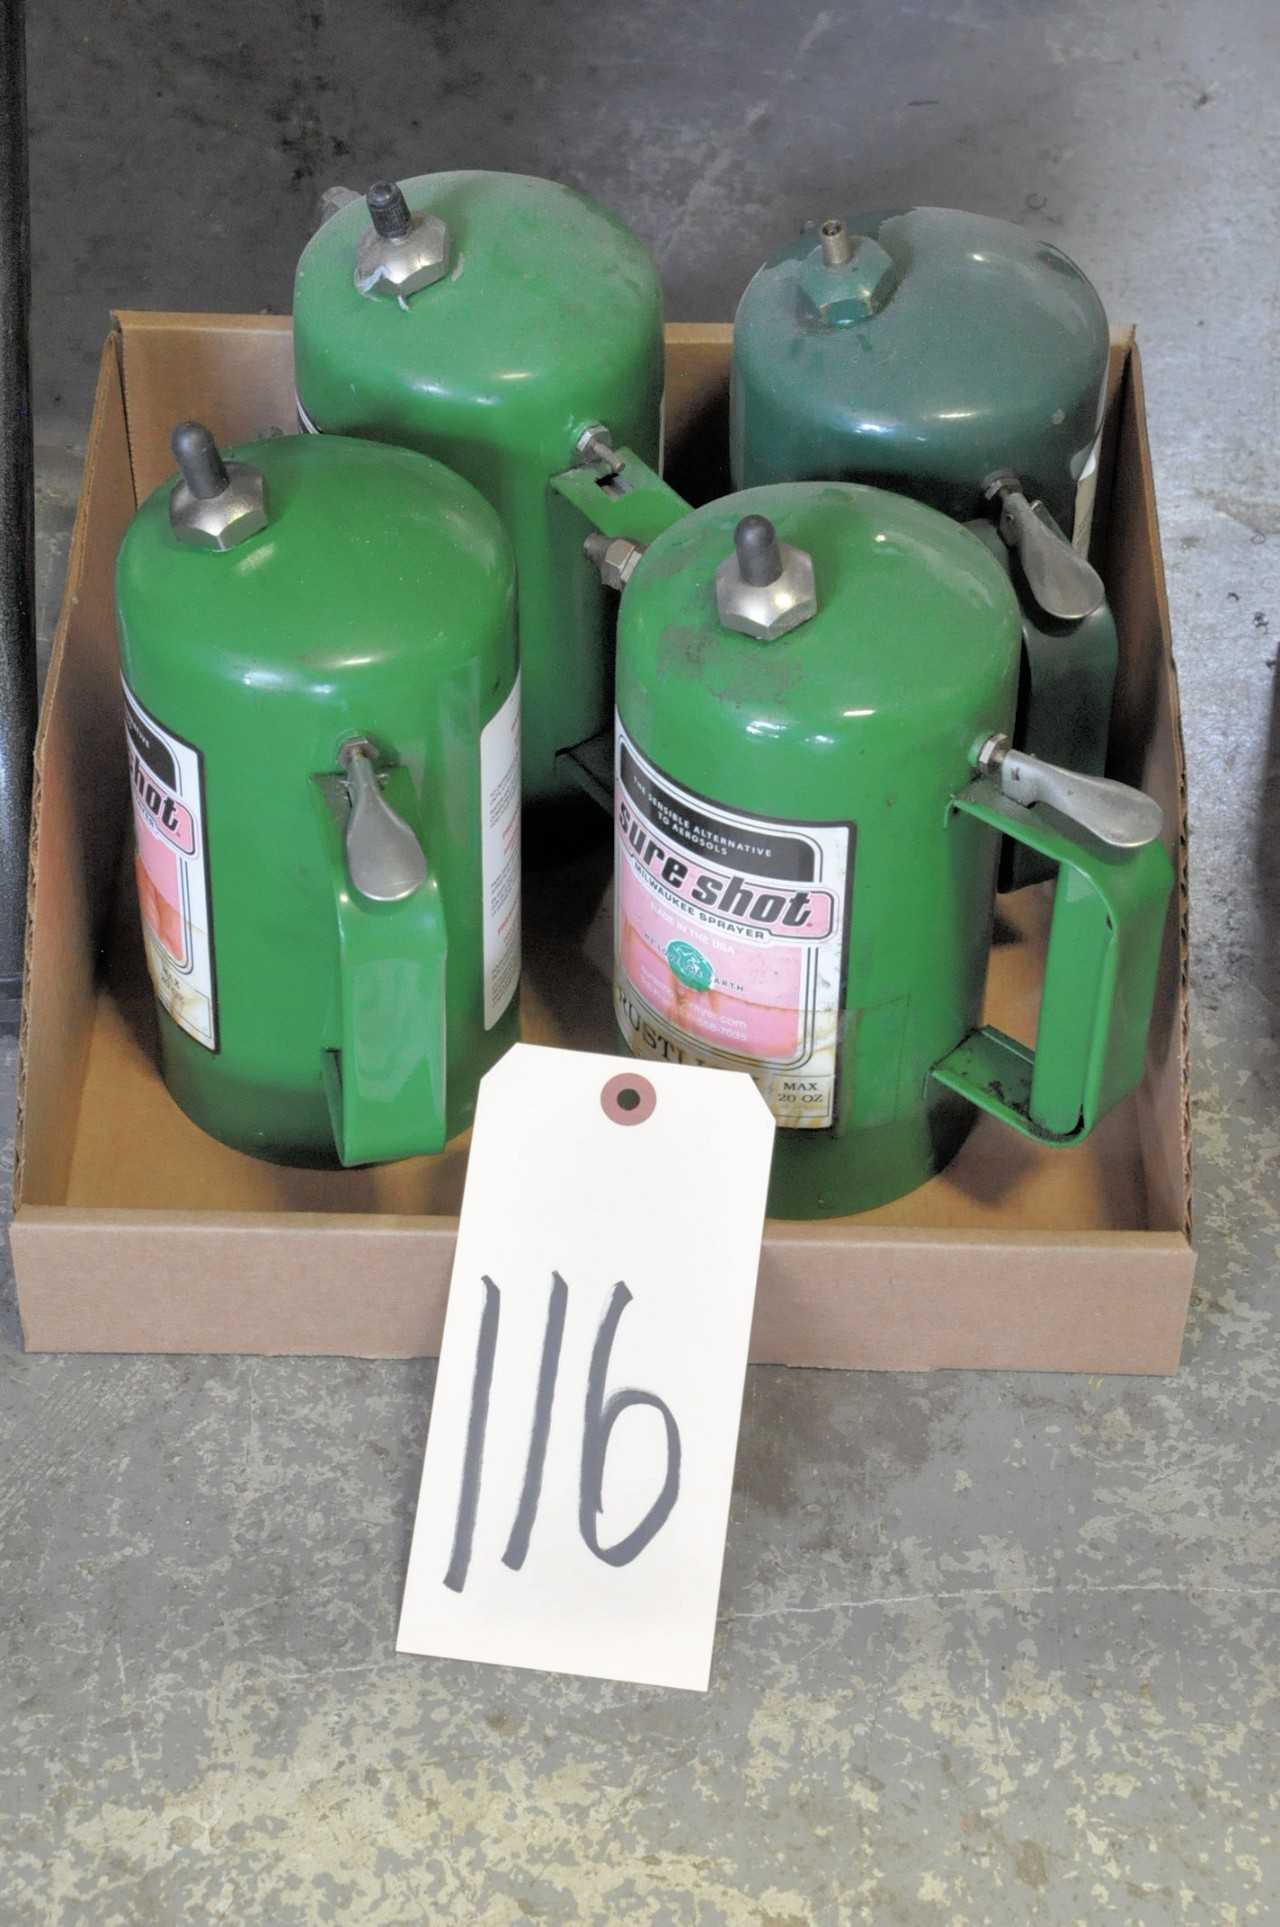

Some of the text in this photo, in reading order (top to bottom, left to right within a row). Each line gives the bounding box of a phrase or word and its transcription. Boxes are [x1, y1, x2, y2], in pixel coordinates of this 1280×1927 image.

[633, 776, 772, 857] THE SENSIBLE ALTERNATIVE
[657, 811, 728, 856] TO AEROSOLS
[632, 860, 764, 939] MILWAUKEE SPRAYER
[777, 1094, 823, 1103] 20 OZ
[783, 1082, 818, 1091] MAX
[443, 1269, 681, 1593] 116
